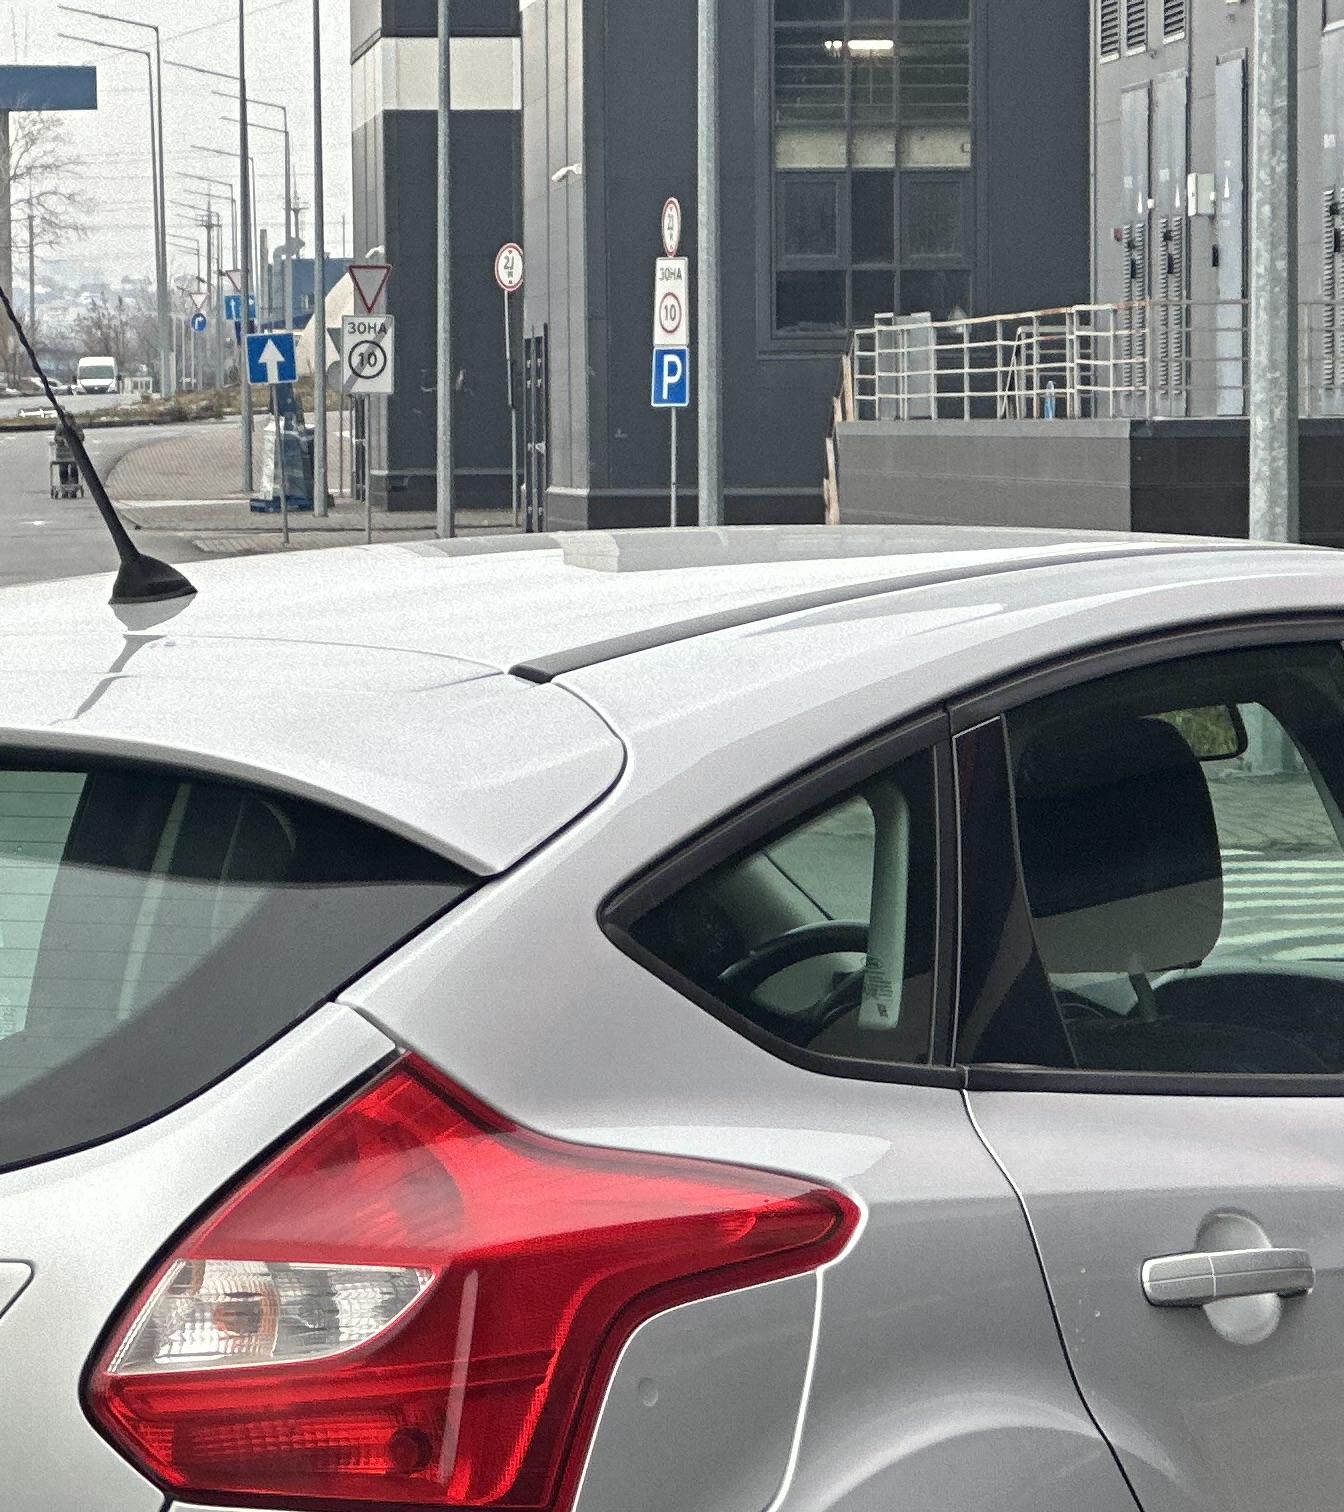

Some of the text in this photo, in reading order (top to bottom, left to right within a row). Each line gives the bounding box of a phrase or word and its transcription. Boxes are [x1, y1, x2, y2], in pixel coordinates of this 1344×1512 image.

[658, 267, 683, 281] ЗОНА
[664, 304, 677, 322] 10
[347, 321, 388, 335] ЗОНА
[358, 353, 378, 368] 10
[662, 353, 683, 400] P
